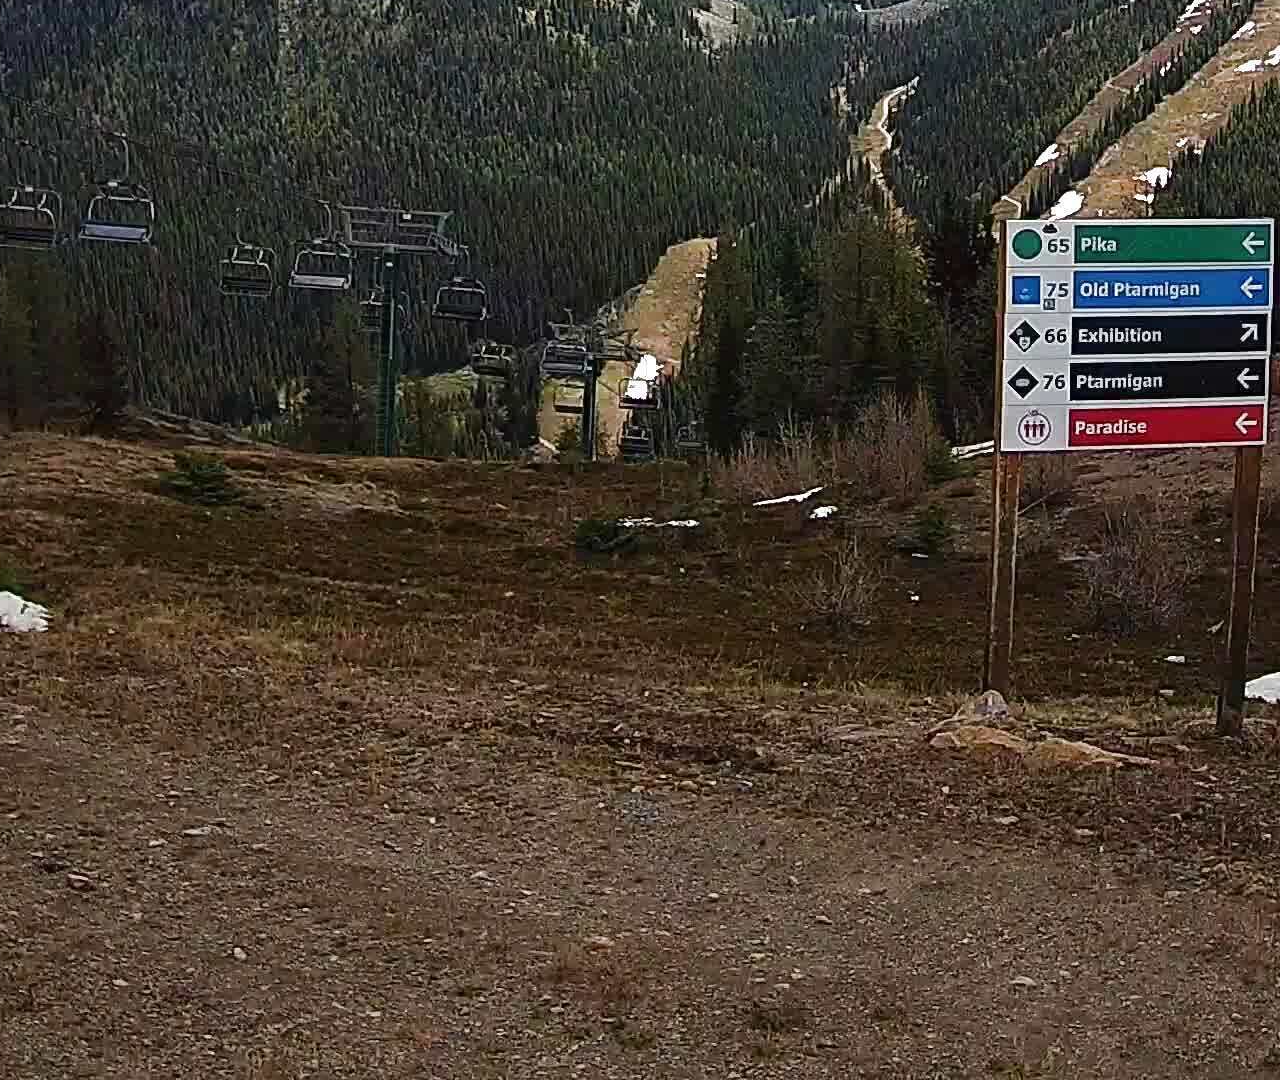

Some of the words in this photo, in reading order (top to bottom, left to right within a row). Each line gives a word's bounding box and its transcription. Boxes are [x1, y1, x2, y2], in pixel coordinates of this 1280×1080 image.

[1047, 238, 1070, 253] 65
[1080, 237, 1117, 253] Pika
[1046, 282, 1069, 298] 75
[1079, 282, 1108, 298] Old
[1114, 281, 1200, 300] Ptarmigan
[1044, 328, 1067, 344] 66
[1078, 327, 1162, 344] Exhibition
[1042, 374, 1066, 390] 76
[1076, 372, 1163, 391] Ptarmigan
[1074, 418, 1148, 435] Paradise
